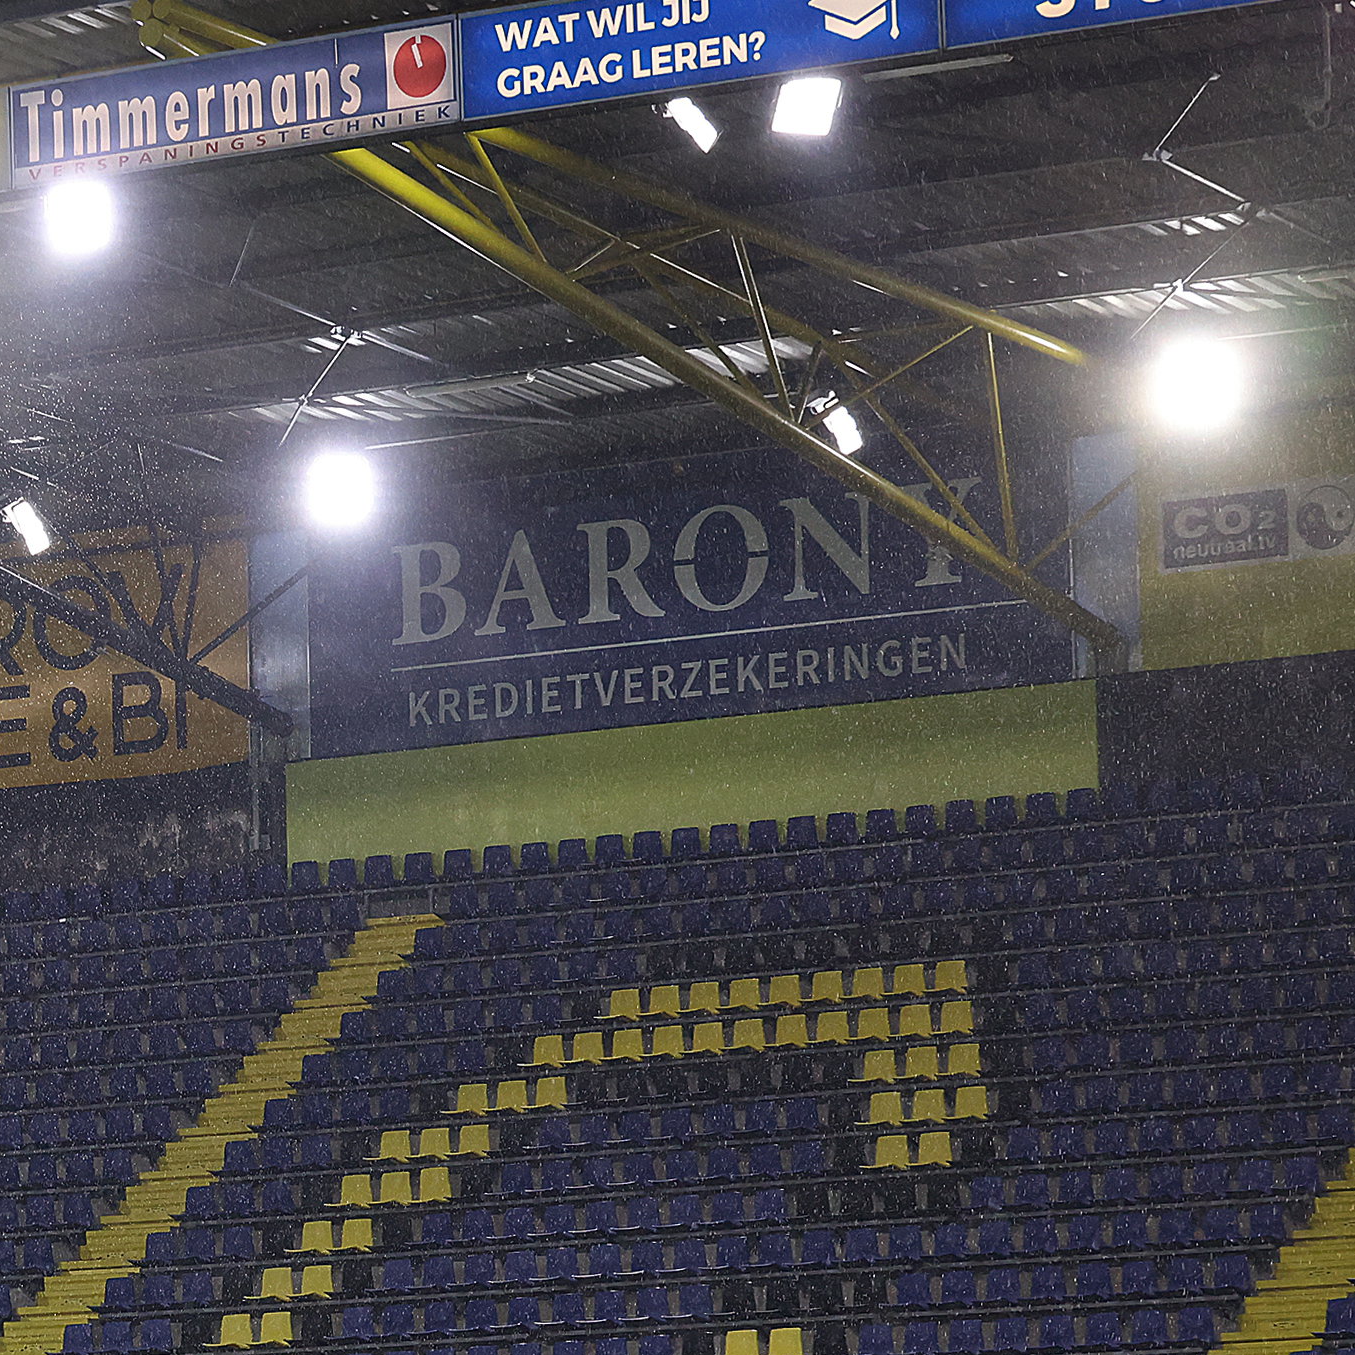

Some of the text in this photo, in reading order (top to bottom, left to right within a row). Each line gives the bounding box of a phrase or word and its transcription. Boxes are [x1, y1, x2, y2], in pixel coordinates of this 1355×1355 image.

[494, 0, 711, 52] WAT WIL JIJ
[496, 31, 767, 98] GRAAG LEREN?
[20, 63, 362, 163] Timmermans
[28, 104, 452, 181] VERSPANINGSTECHNIEK
[393, 477, 982, 645] BARONY
[408, 632, 966, 727] KREDIETVERZEKERINGEN
